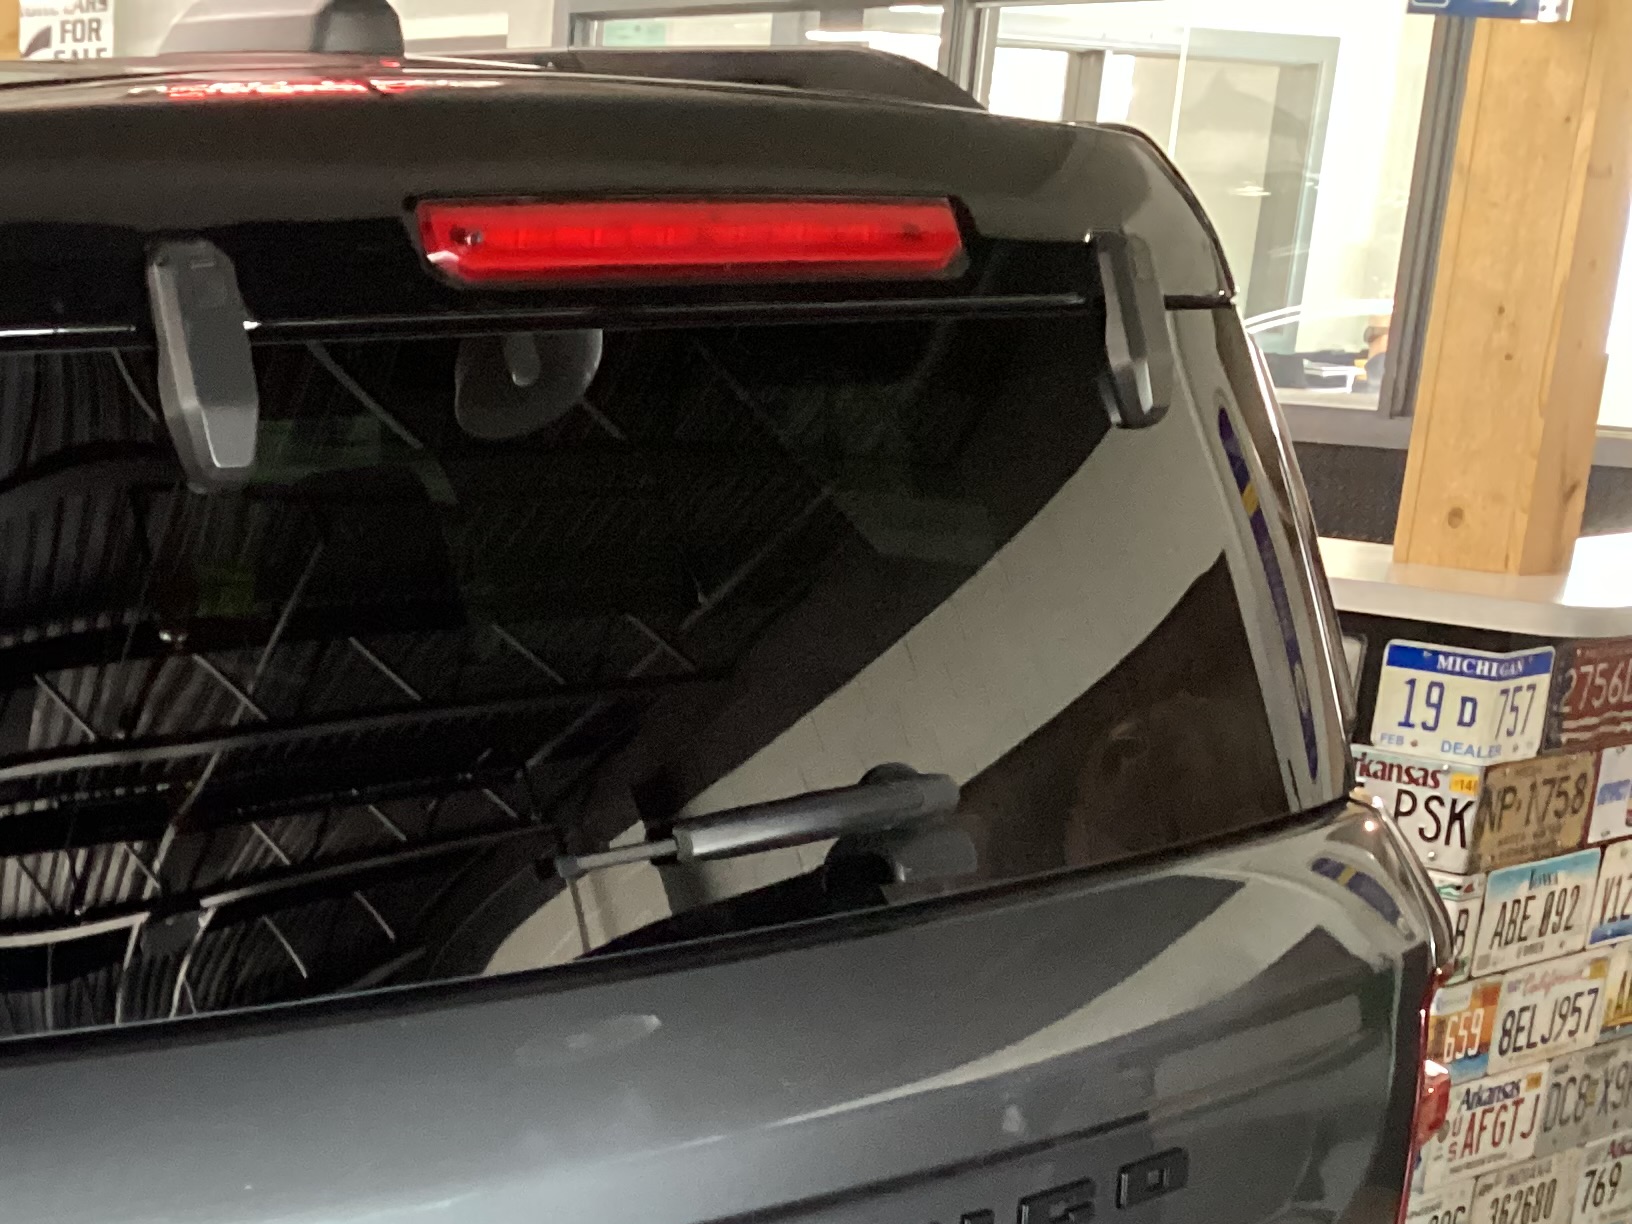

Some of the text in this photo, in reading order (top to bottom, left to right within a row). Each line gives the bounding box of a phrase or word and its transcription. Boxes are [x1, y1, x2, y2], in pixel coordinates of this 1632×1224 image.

[59, 17, 102, 44] FOR
[1436, 654, 1524, 678] MICHIGAN
[1397, 678, 1537, 741] 19 D 757
[1380, 733, 1404, 746] FEB
[1441, 740, 1502, 759] DEALER
[1394, 788, 1475, 849] PSK
[1489, 895, 1536, 950] ABE
[1443, 1008, 1485, 1063] 659
[1581, 1161, 1622, 1214] 769
